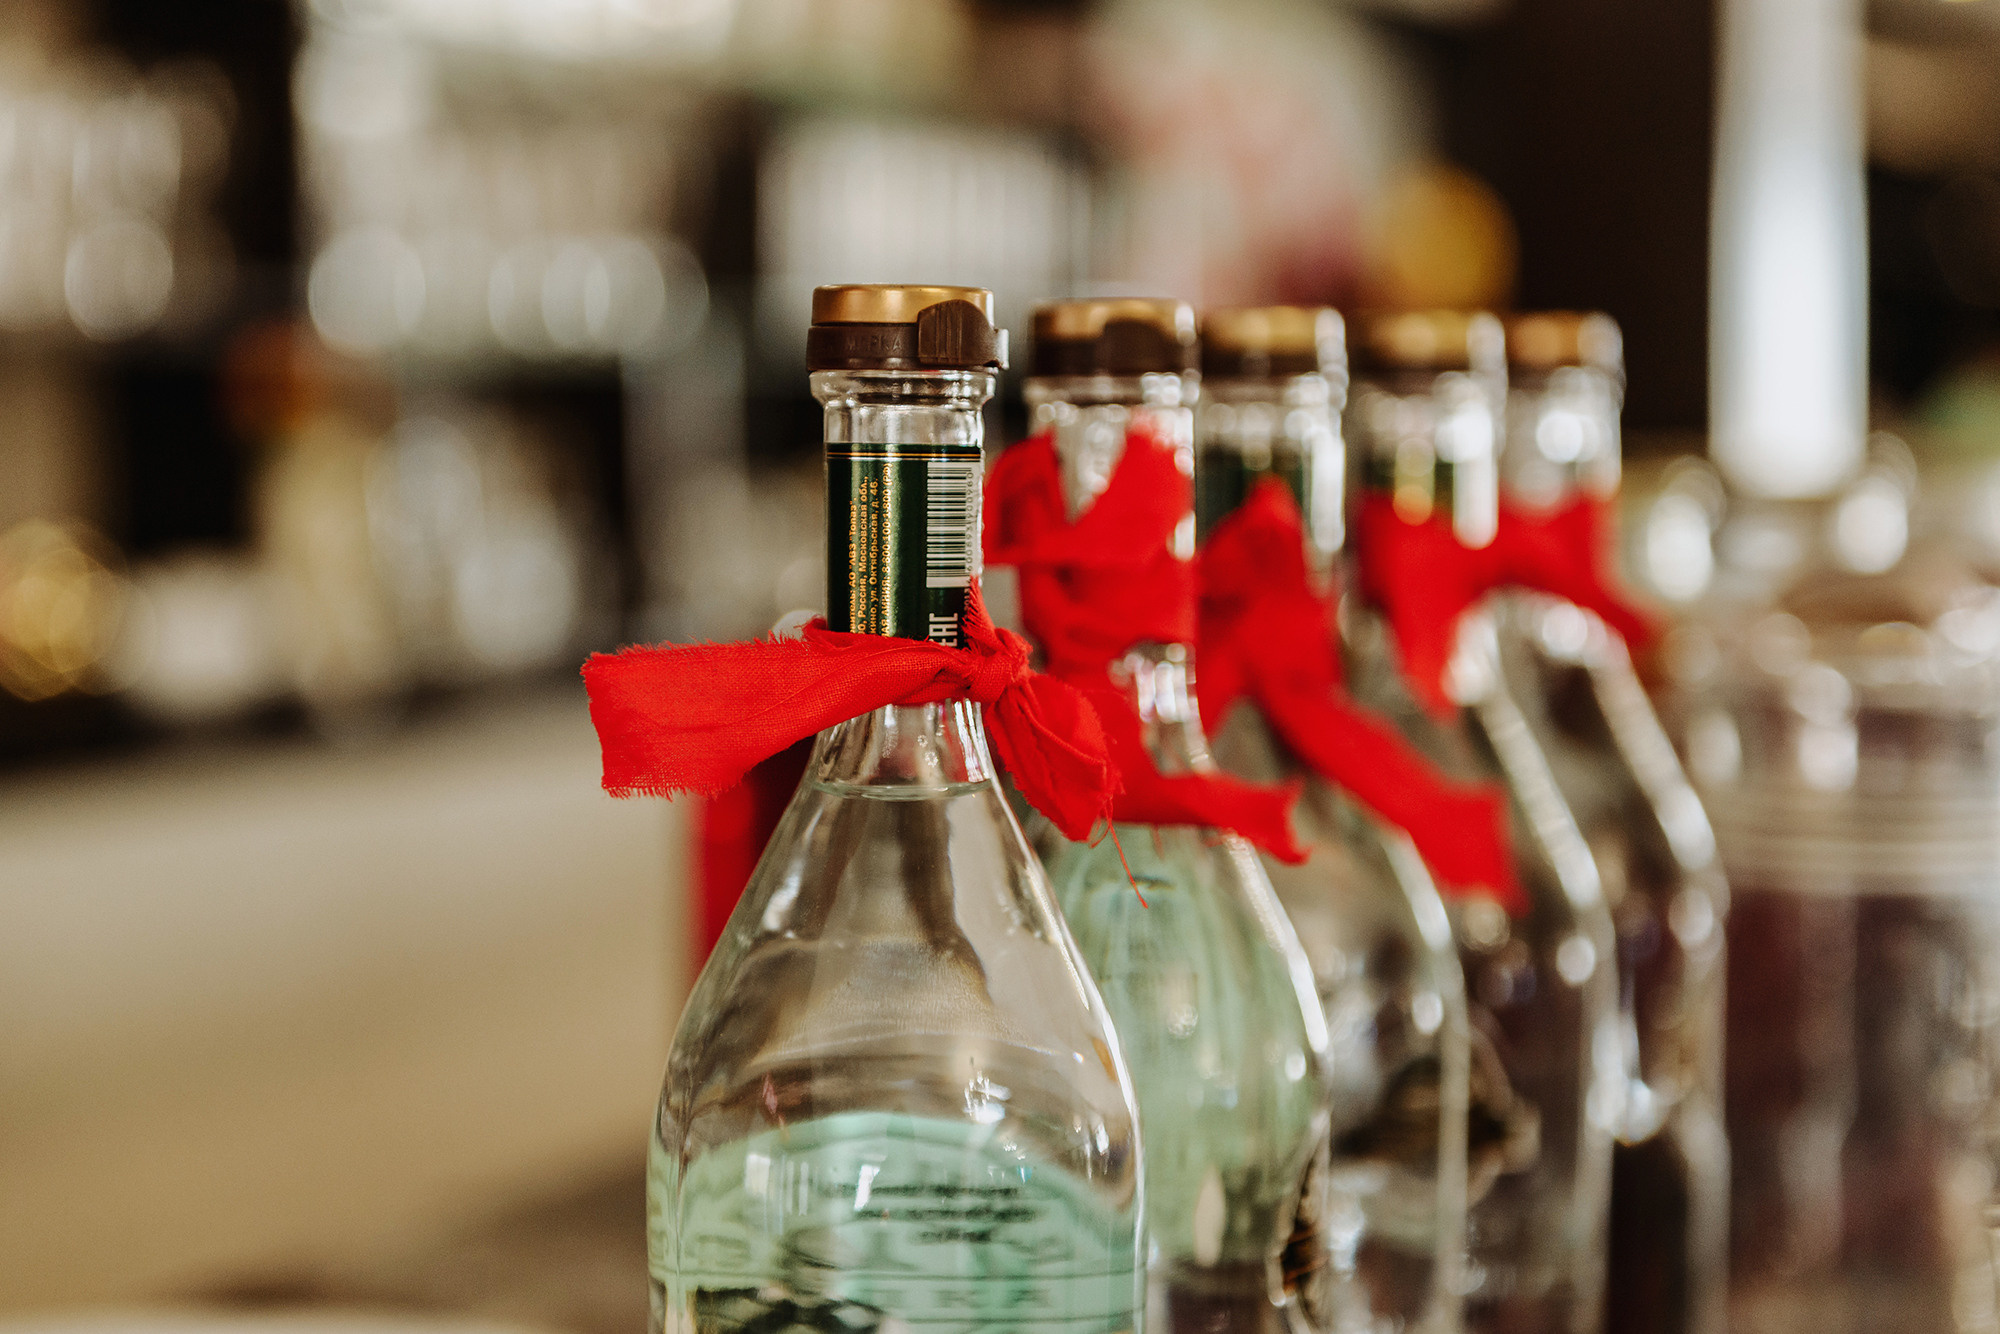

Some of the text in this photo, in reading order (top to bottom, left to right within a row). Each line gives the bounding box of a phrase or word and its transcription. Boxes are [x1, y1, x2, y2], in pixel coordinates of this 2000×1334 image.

[858, 476, 868, 502] обл.,
[882, 462, 893, 486] (РФ)
[858, 504, 868, 573] Московская
[869, 510, 879, 586] Октябрьская,
[881, 488, 891, 573] 8-800-100-1-800
[848, 571, 856, 588] АО
[857, 574, 868, 618] Россия,
[870, 587, 879, 602] ул.
[881, 576, 891, 617] ЛИНИЯ:
